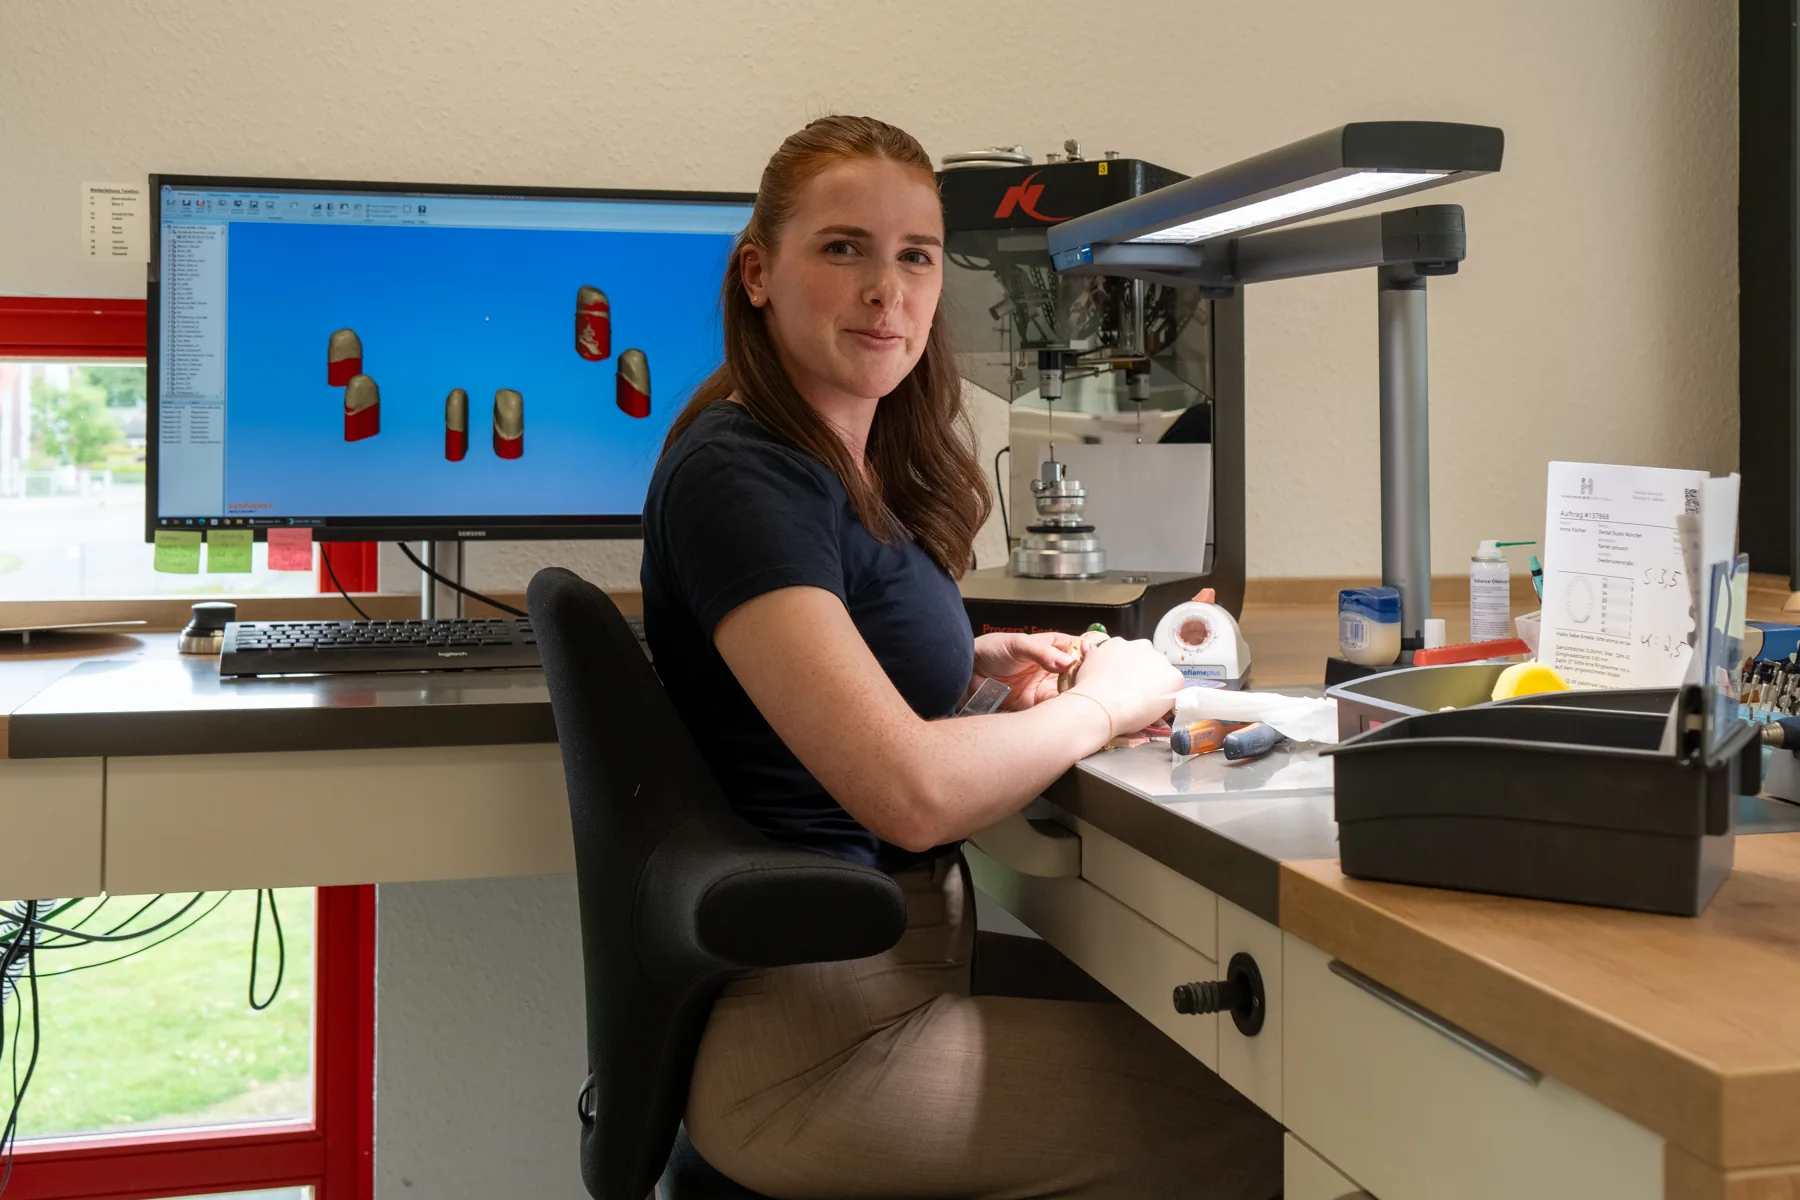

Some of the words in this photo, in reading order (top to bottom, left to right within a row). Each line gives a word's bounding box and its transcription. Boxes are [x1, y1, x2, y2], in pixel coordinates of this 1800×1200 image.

[1100, 164, 1106, 173] 3
[1560, 510, 1583, 519] Auftrag
[1179, 669, 1221, 677] oflameplus
